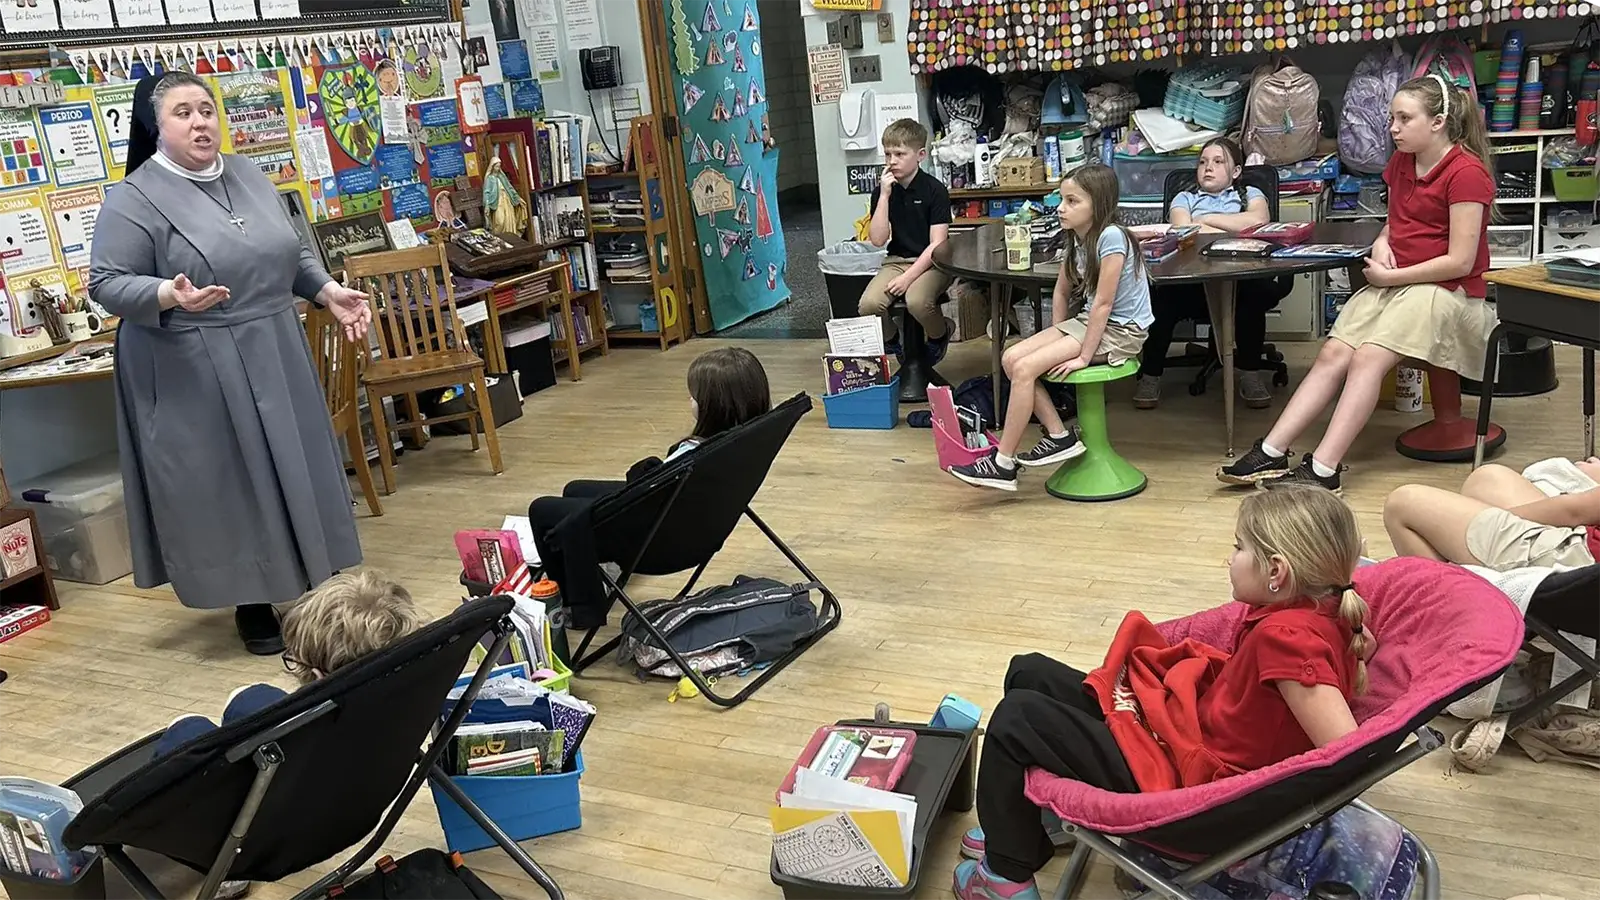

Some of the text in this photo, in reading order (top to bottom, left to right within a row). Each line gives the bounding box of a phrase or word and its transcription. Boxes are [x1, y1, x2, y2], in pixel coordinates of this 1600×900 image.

[4, 84, 62, 104] FAITH
[96, 94, 127, 103] QUESTION
[51, 110, 83, 122] PERIOD
[246, 111, 267, 121] THINGS
[850, 169, 877, 180] South
[51, 193, 100, 209] APOSTROPHE
[11, 272, 61, 290] SEMOLON
[660, 287, 678, 328] D
[3, 536, 28, 553] NUTS
[4, 623, 20, 636] Art
